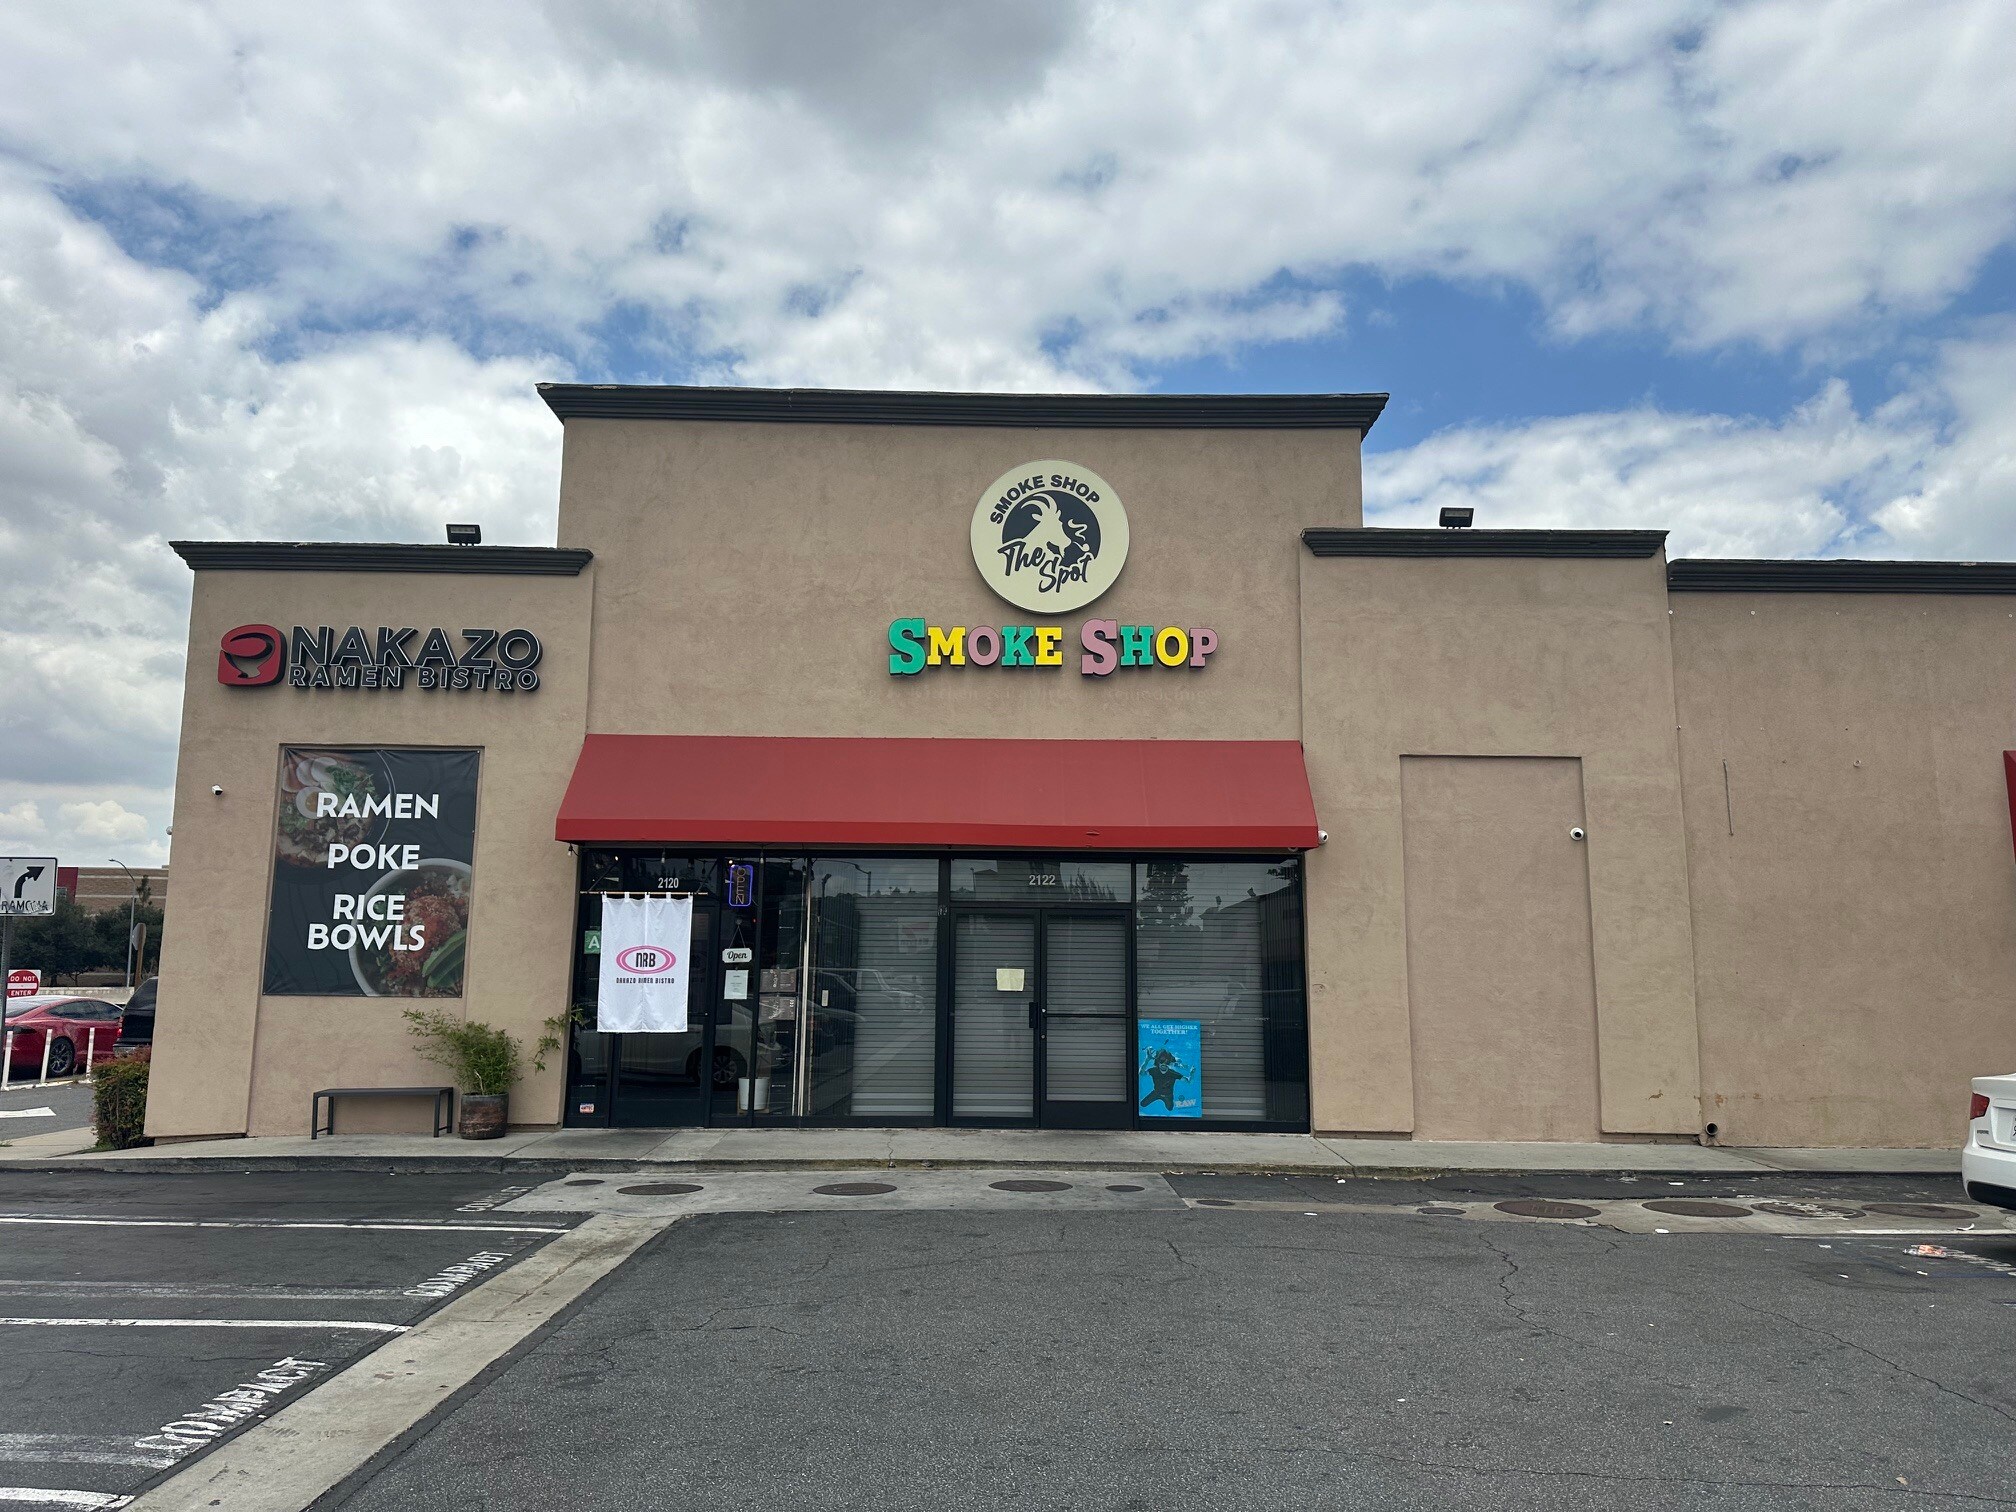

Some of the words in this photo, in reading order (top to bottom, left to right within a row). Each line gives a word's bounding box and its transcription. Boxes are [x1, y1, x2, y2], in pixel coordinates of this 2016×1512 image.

[990, 475, 1045, 524] SMOKE
[1050, 474, 1100, 503] SHOP
[997, 541, 1046, 576] The
[1038, 555, 1093, 593] Spot
[290, 625, 543, 670] NAKAZO
[888, 618, 1063, 676] SMOKE
[1080, 618, 1219, 676] SHOP
[288, 665, 403, 690] RAMEN
[416, 666, 542, 691] BISTRO
[316, 792, 440, 819] RAMEN
[327, 843, 420, 870] POKE
[657, 877, 679, 889] 2120
[1028, 874, 1056, 886] 2122
[332, 893, 406, 921] RICE
[307, 923, 426, 951] BOWLS
[588, 935, 600, 949] A
[635, 952, 656, 968] NRB
[727, 950, 748, 961] Open
